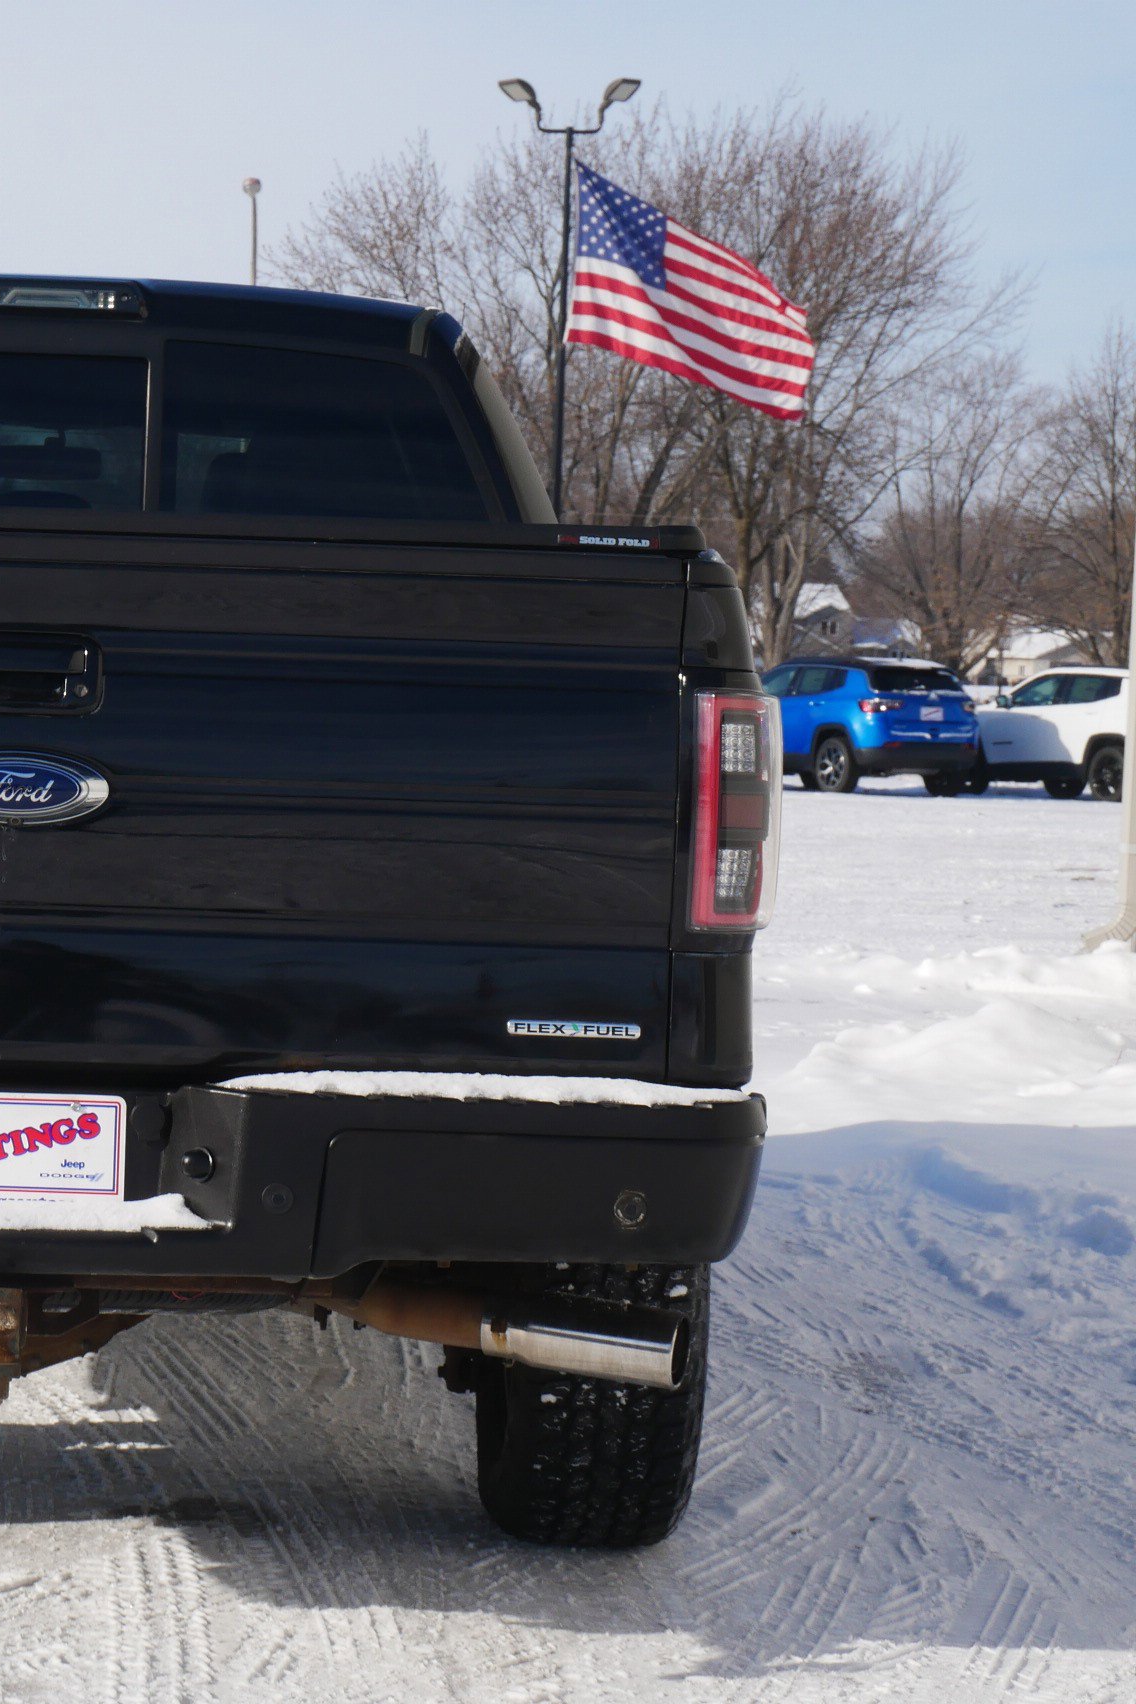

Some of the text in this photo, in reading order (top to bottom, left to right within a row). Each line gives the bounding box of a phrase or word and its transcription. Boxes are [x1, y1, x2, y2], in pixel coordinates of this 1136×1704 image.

[579, 536, 650, 547] SOLID FOLD
[514, 1022, 636, 1037] FLEX FUEL
[60, 1158, 85, 1169] Jeep
